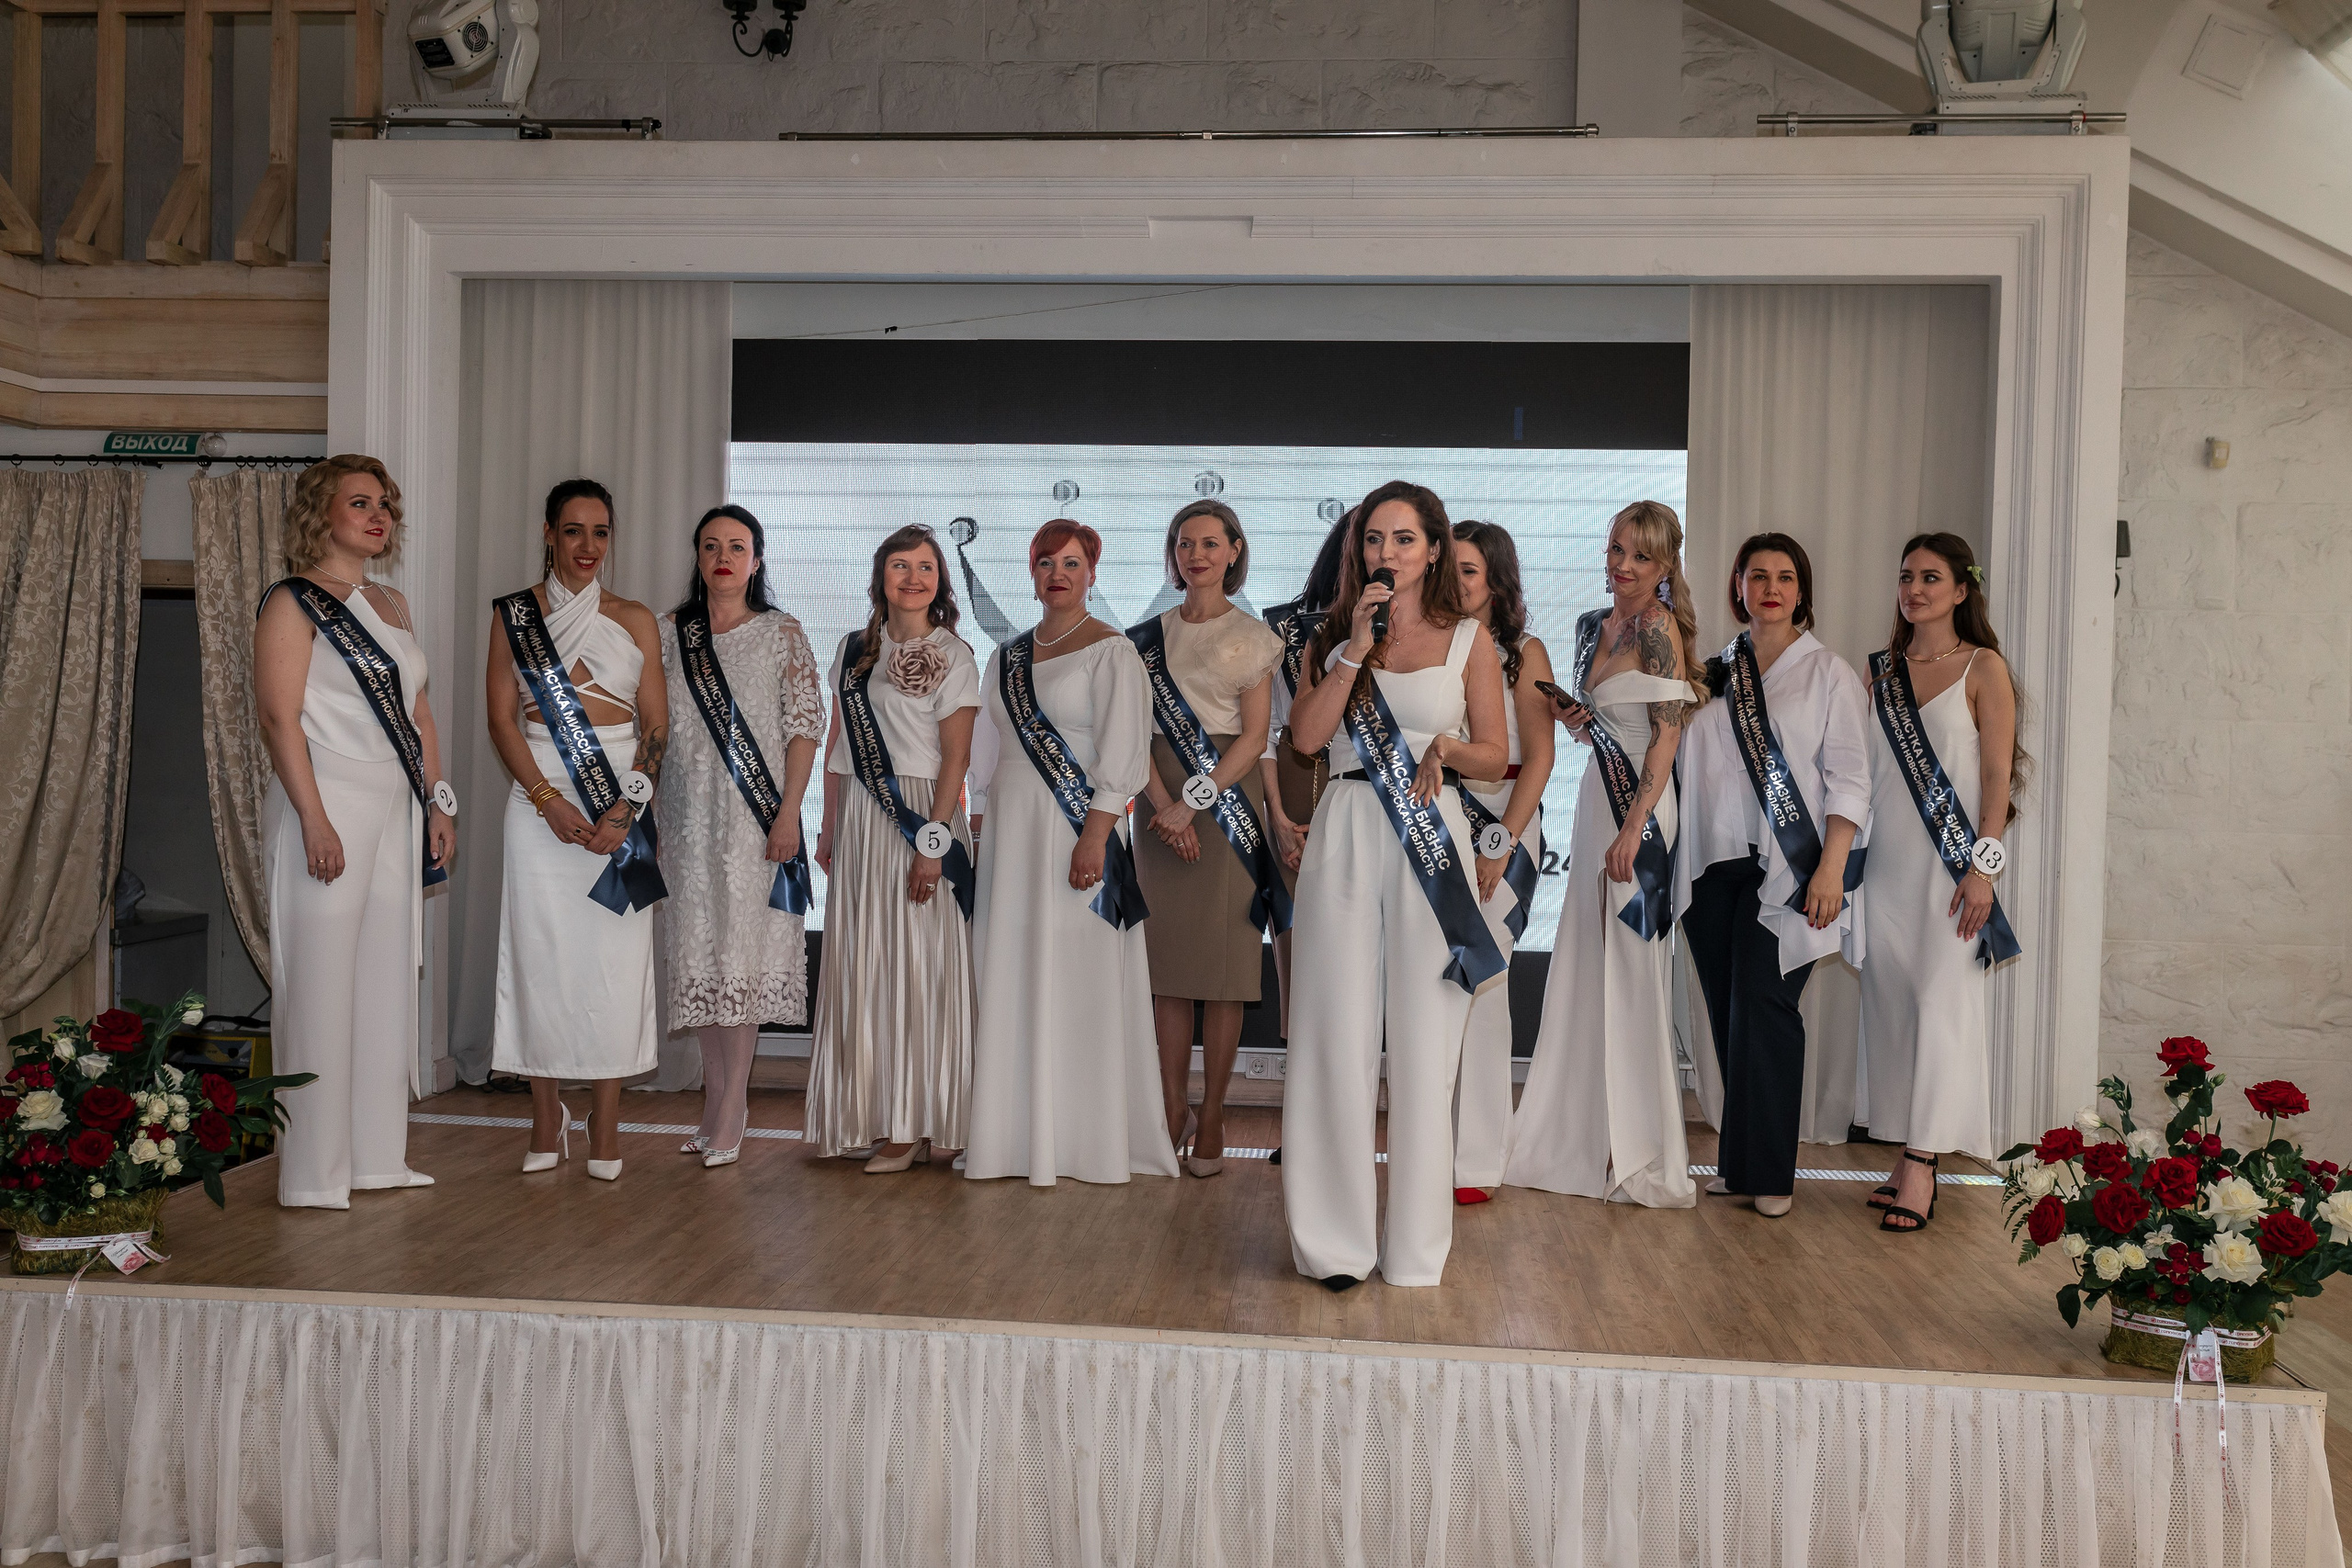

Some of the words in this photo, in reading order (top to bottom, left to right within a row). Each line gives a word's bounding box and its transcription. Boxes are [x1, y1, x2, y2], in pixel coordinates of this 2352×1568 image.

[111, 434, 189, 452] ВЫХОД
[331, 625, 381, 692] НОВОСИБИРСК
[342, 621, 396, 706] ФИНАЛИСТКА
[688, 652, 714, 709] НОВОСИБИРСК
[375, 690, 385, 700] И
[516, 632, 547, 693] НОВОСИБИРСК
[542, 693, 550, 701] И
[547, 701, 589, 780] НОВОСИБИРСКАЯ
[583, 779, 606, 814] ОБЛАСТ
[527, 627, 571, 710] ФИНАЛИСТКА
[562, 709, 597, 766] МИССИС
[590, 765, 616, 807] БИЗНЕ
[708, 708, 718, 716] И
[1736, 702, 1744, 710] И
[1881, 682, 1905, 742] НОВОСИБИРСК
[379, 698, 417, 773] НОВОСИБИРСКАЯ
[698, 648, 732, 725] ФИНАЛИСТКА
[727, 722, 761, 775] МИССИС
[755, 774, 779, 813] БИЗНЕ
[712, 716, 756, 789] НОВОСИБИРСКАЯ
[846, 695, 867, 760] НОВОСИБИРСК
[854, 692, 883, 777] ФИНАЛИСТКА
[1014, 666, 1046, 739] ФИНАЛИСТКА
[1043, 737, 1080, 788] МИССИС
[1357, 724, 1369, 734] И
[1737, 652, 1757, 716] ФИНАЛИСТКА
[1748, 716, 1776, 771] МИССИС
[1769, 771, 1800, 822] БИЗНЕС
[1737, 708, 1768, 784] НОВОСИБИРСКАЯ
[1890, 677, 1924, 759] ФИНАЛИСТКА
[1917, 757, 1951, 813] МИССИС
[1899, 740, 1908, 750] И
[628, 780, 644, 795] 3
[1021, 725, 1029, 734] И
[1025, 732, 1074, 802] НОВОСИБИРСКАЯ
[1070, 801, 1085, 824] ОБЛ
[1150, 683, 1182, 740] ОВОСИБИРСК
[1178, 739, 1187, 748] И
[1227, 816, 1252, 854] ОБЛАСТЬ
[1154, 674, 1204, 753] ФИНАЛИСТКА
[1231, 801, 1261, 848] БИЗНЕС
[1186, 778, 1213, 807] 12
[1362, 733, 1414, 826] НОВОСИБИРСКАЯ
[1593, 735, 1624, 805] НОВОСИБИРСКАЯ
[1606, 739, 1631, 791] МИССИС
[1903, 749, 1944, 828] НОВОСИБИРСКАЯ
[439, 789, 453, 808] 2
[1763, 784, 1787, 828] ОБЛАСТЬ
[928, 830, 940, 850] 5
[1408, 826, 1436, 876] ОБЛАСТЬ
[1415, 809, 1451, 871] БИЗНЕС
[1488, 831, 1502, 851] 9
[1939, 827, 1964, 869] ОБЛАСТЬ
[1974, 840, 2002, 870] 13
